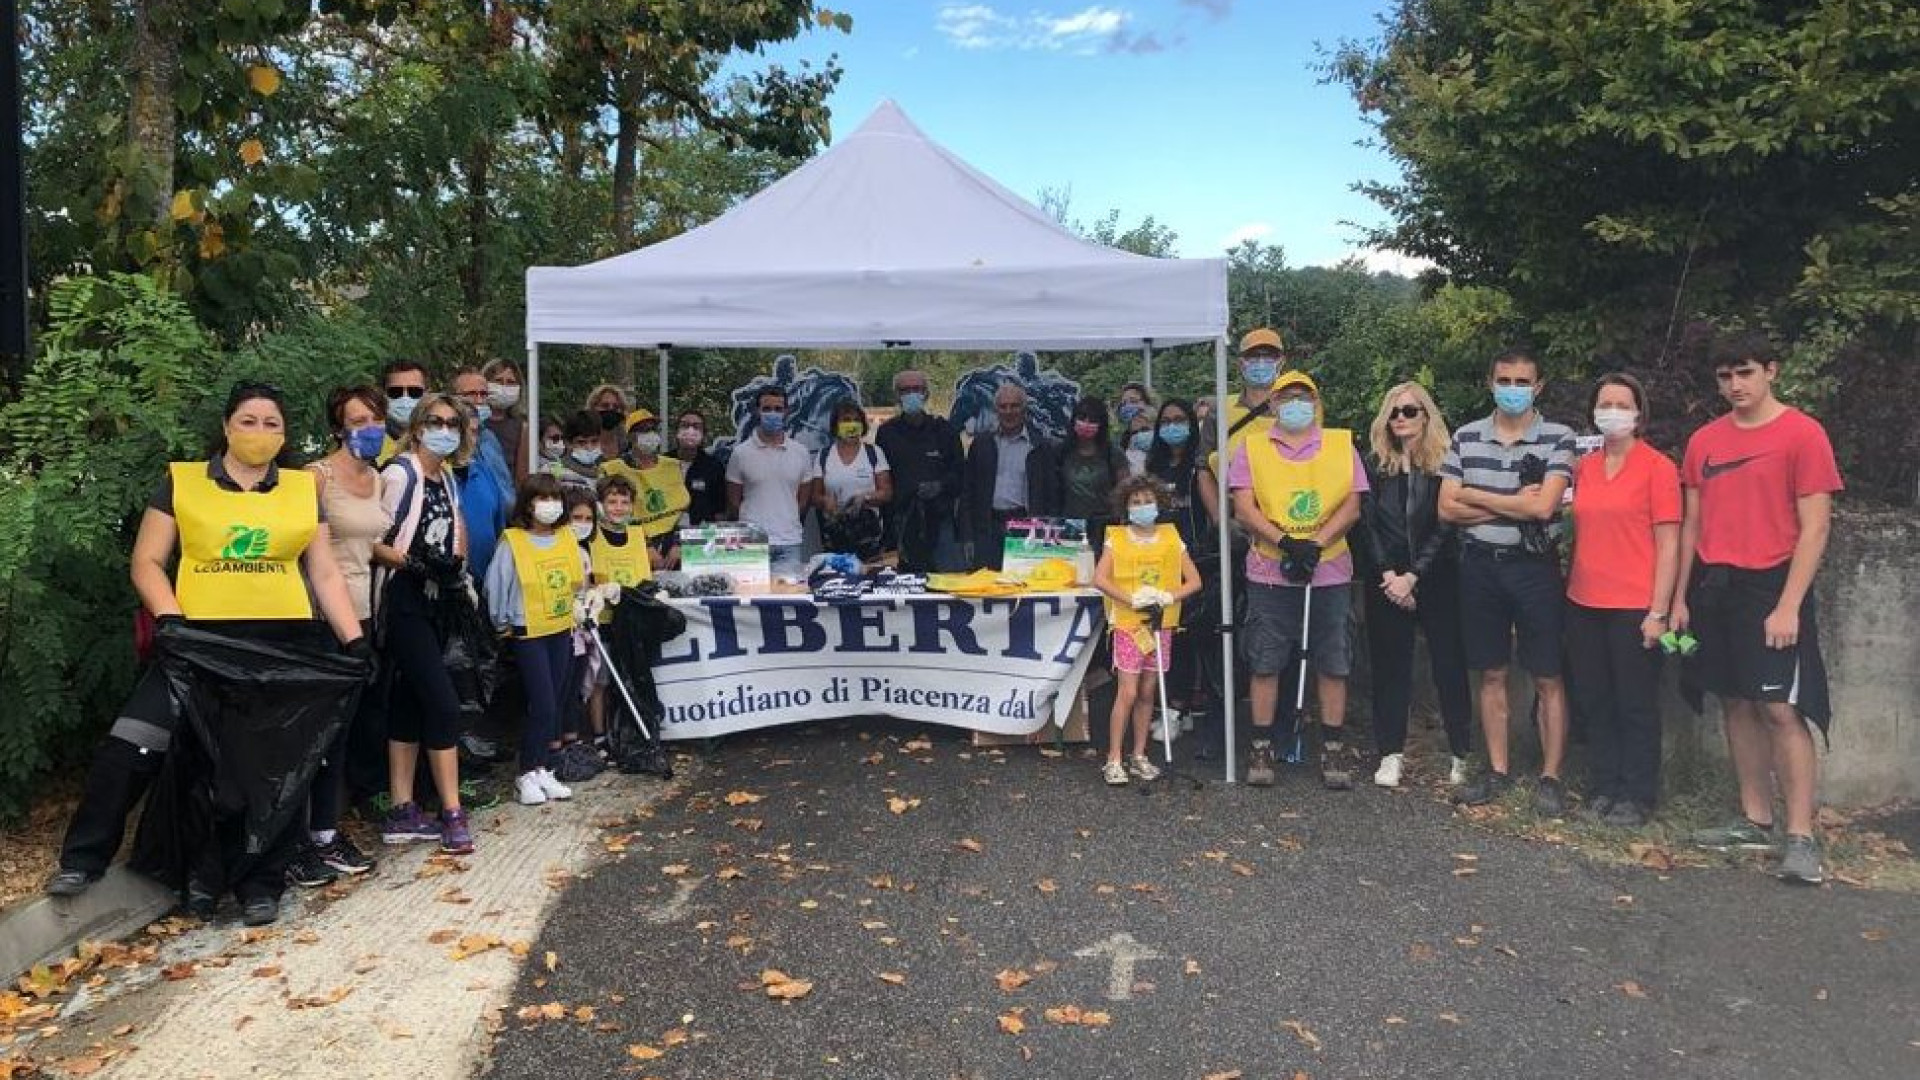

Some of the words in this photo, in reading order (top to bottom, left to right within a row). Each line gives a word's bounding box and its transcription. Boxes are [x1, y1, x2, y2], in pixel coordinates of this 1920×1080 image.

[658, 684, 811, 724] uotidiano
[822, 677, 850, 704] di
[861, 677, 991, 714] Piacenza
[998, 689, 1036, 720] dal
